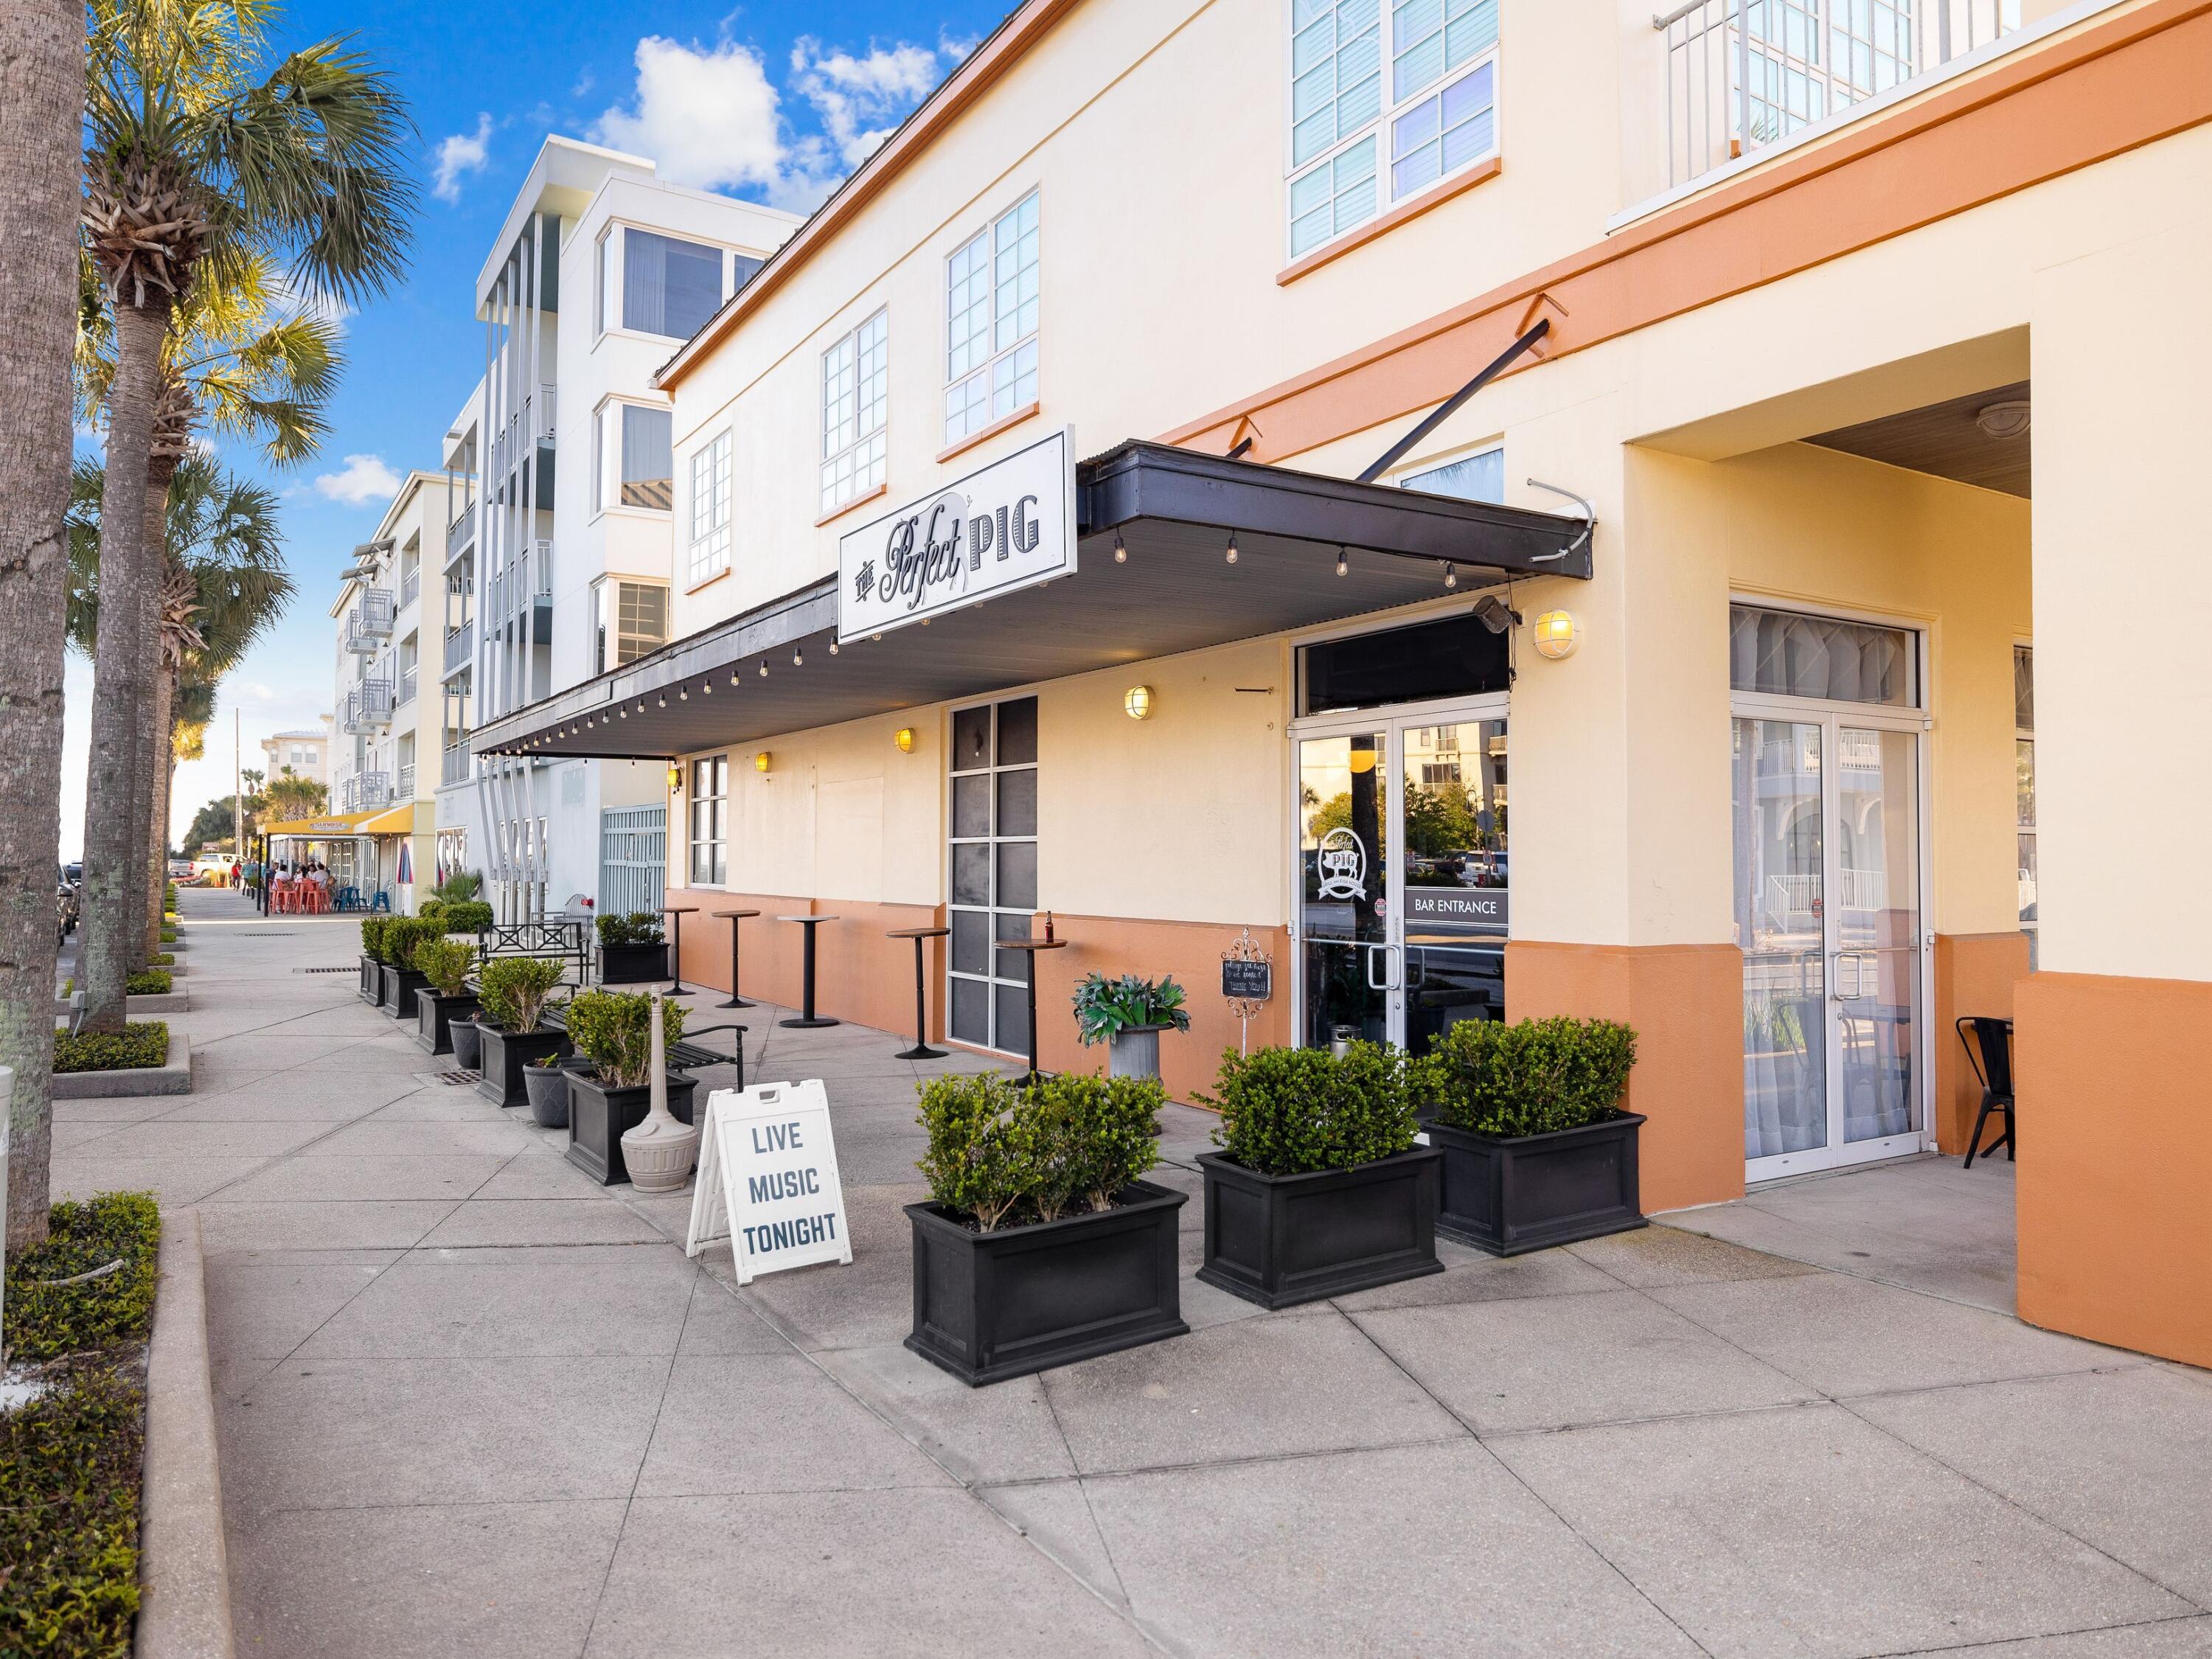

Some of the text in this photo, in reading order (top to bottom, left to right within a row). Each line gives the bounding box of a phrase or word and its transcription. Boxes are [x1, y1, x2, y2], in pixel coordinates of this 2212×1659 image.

[855, 495, 1039, 610] THE Perfect PIG
[1332, 854, 1354, 866] PIG
[1415, 899, 1497, 914] BAR ENTRANCE
[751, 1122, 803, 1154] LIVE
[748, 1167, 819, 1204] MUSIC
[742, 1213, 835, 1255] TONIGHT
